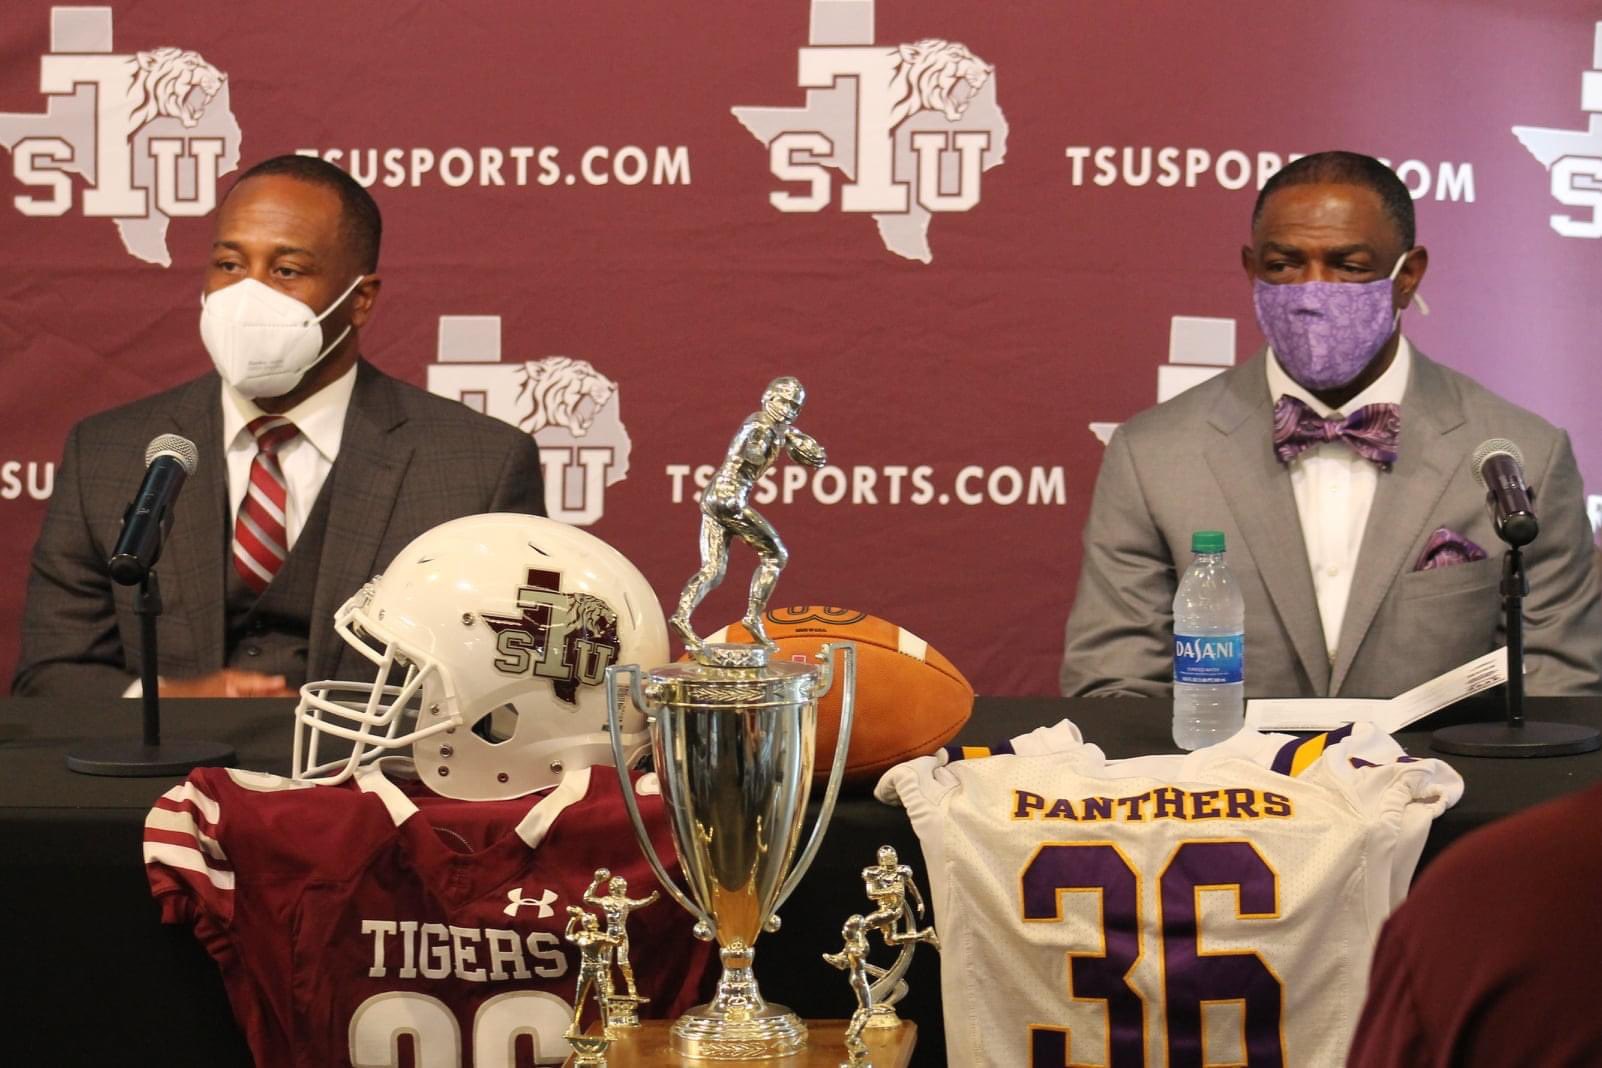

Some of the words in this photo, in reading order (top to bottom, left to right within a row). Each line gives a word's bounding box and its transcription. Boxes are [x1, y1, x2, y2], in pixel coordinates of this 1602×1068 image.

[295, 148, 691, 188] USPORTS.COM
[1066, 147, 1475, 202] TSUSPOROM
[666, 465, 1066, 505] TSSPORTS.COM
[1176, 638, 1233, 664] DASANI
[1013, 787, 1292, 822] PANTHERS
[361, 919, 569, 983] TIGERS
[1021, 841, 1285, 1068] 36
